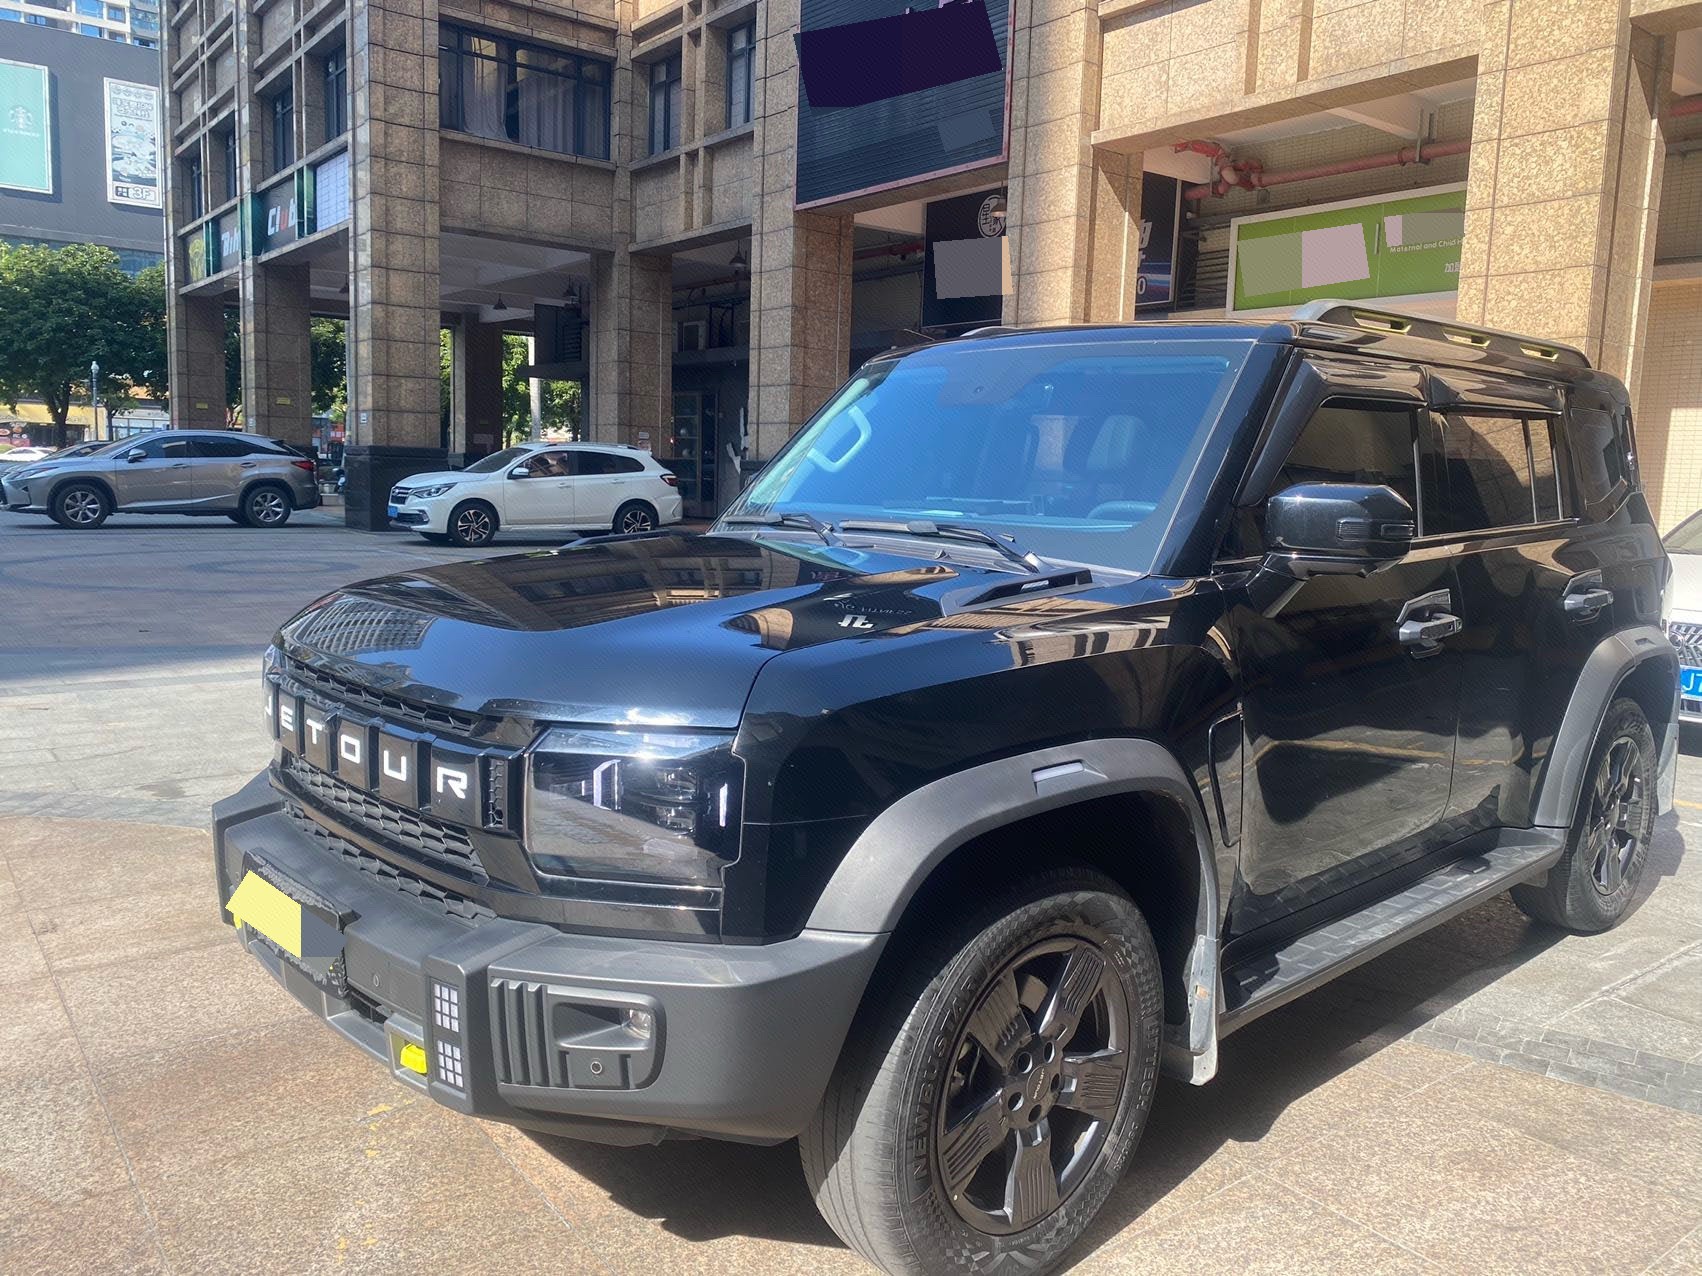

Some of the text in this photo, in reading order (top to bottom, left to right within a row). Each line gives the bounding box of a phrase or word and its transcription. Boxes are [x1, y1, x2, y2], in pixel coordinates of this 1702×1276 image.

[133, 187, 151, 199] 3F
[1423, 241, 1437, 249] and
[265, 695, 468, 799] JETOUR
